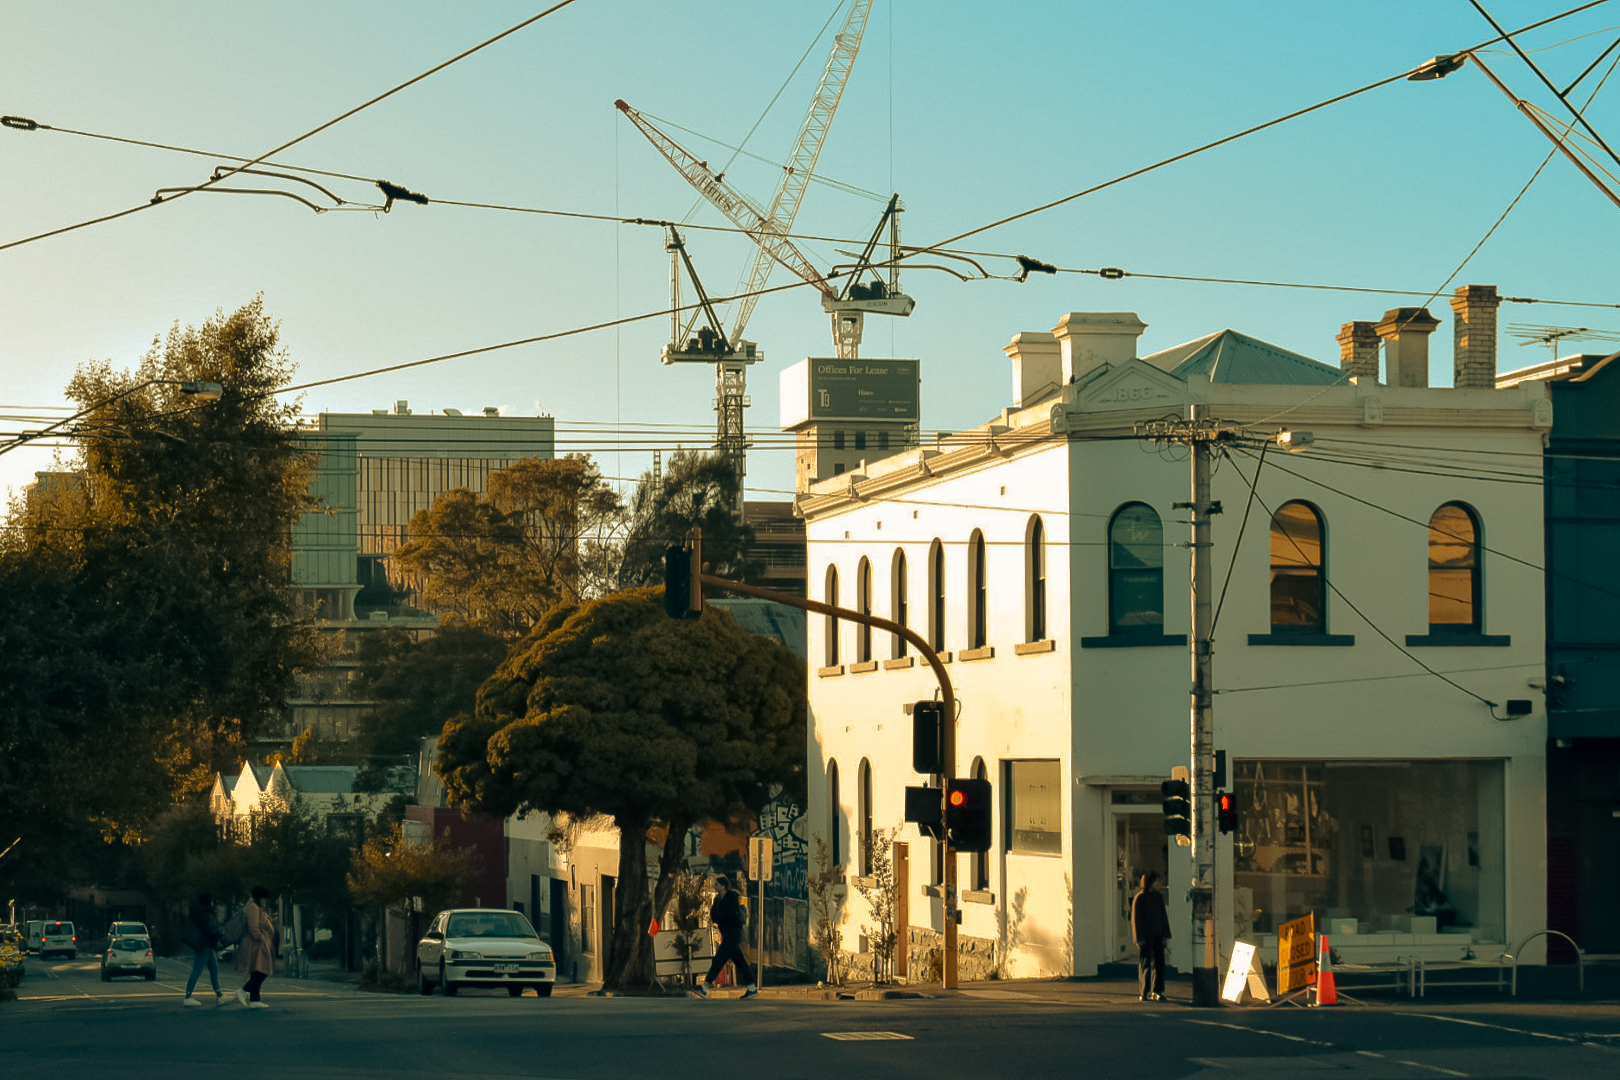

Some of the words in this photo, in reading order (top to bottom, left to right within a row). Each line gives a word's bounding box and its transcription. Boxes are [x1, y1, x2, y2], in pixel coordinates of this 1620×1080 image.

[817, 364, 847, 375] Offices
[849, 365, 863, 375] For
[865, 365, 889, 376] Lease
[1285, 920, 1306, 941] ROAD
